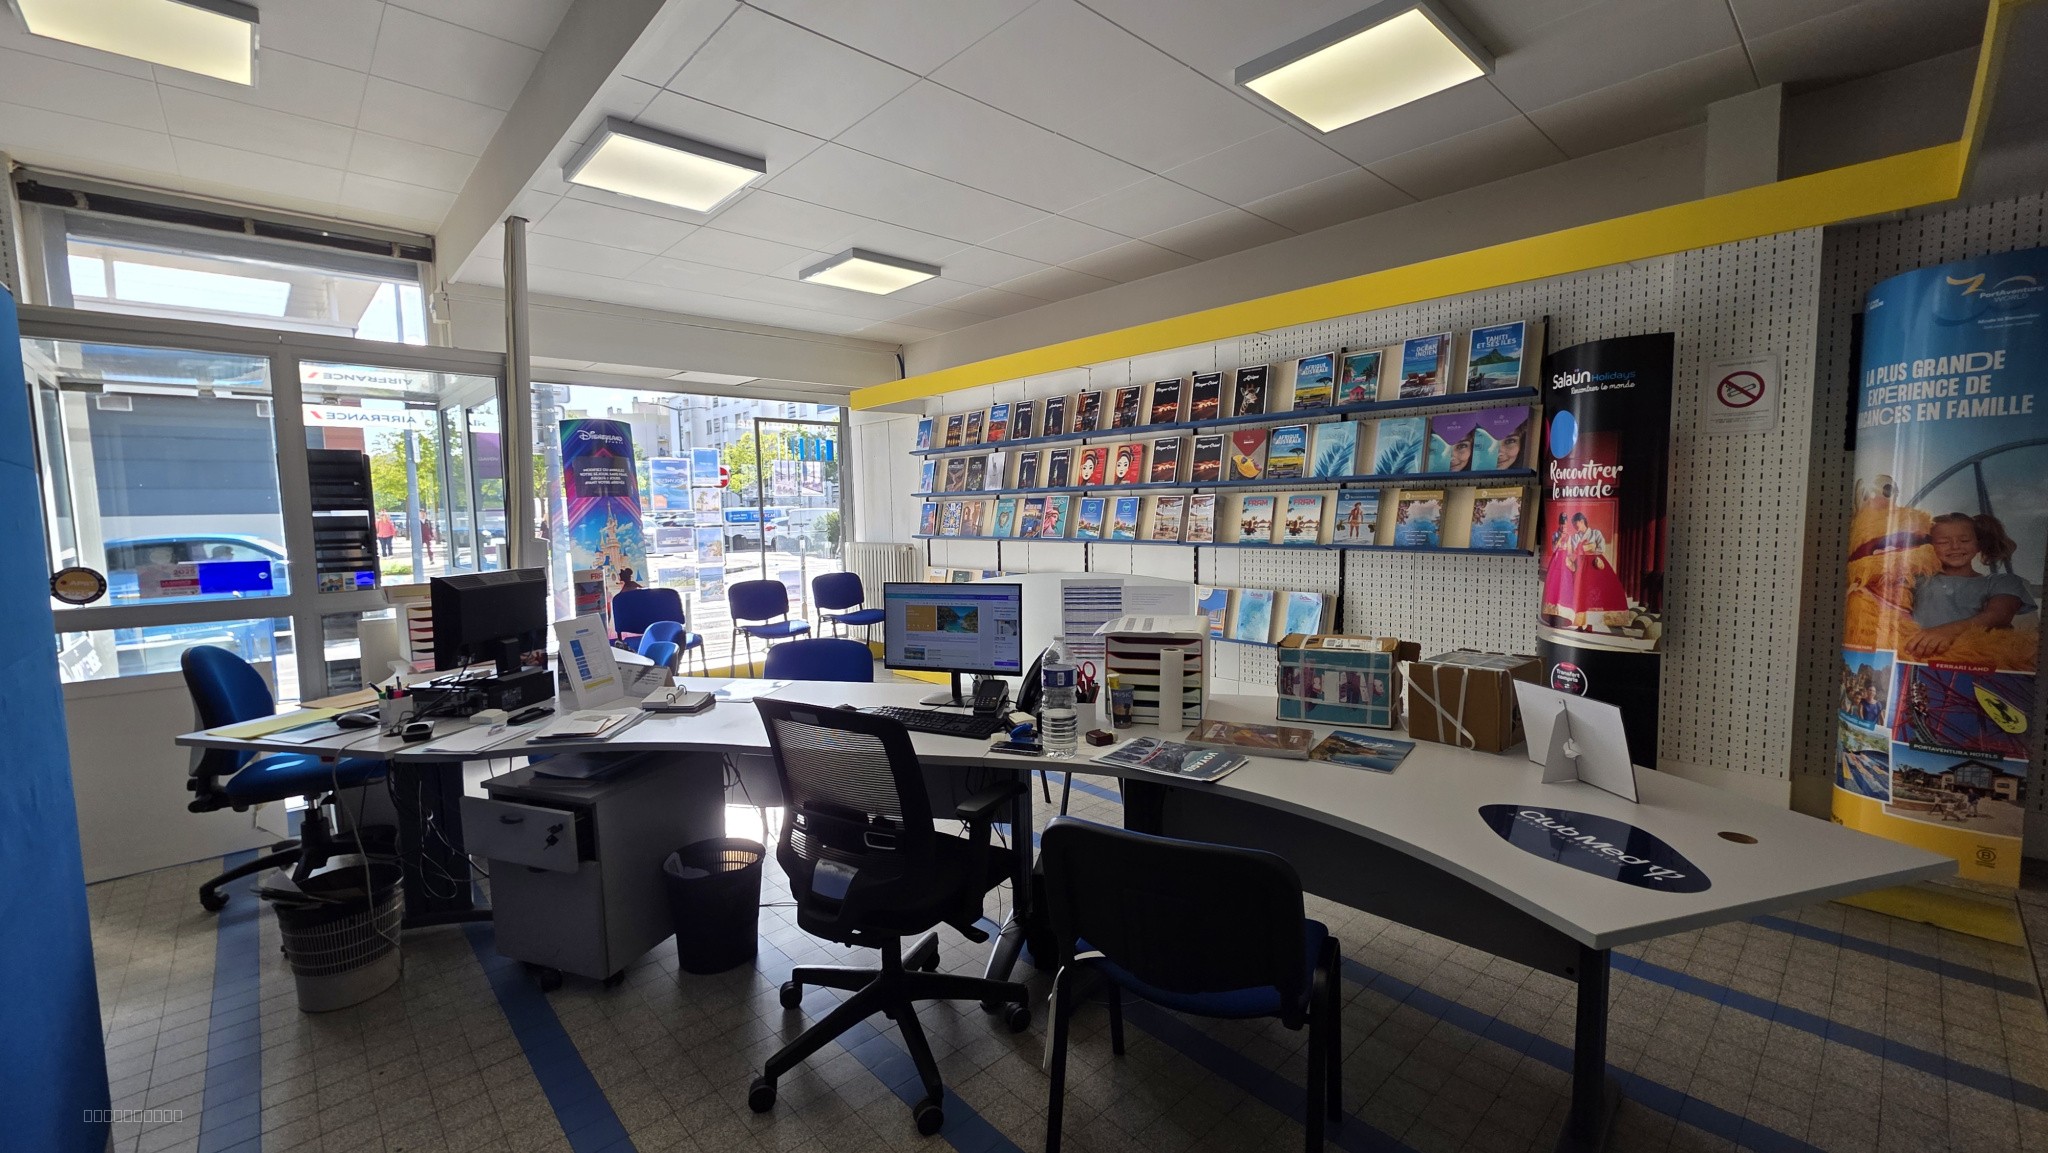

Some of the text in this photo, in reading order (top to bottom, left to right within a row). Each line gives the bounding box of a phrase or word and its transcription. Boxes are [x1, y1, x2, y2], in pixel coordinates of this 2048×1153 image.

[1591, 370, 1636, 382] Holidays
[1866, 349, 2006, 388] LA PLUS GRANDE
[1965, 374, 1992, 396] DE
[1916, 401, 1941, 421] EN
[1946, 394, 2035, 420] FAMILLE
[1550, 459, 1623, 484] Rencontrer
[1552, 478, 1614, 500] le monde
[1247, 499, 1269, 507] FRAM
[1294, 498, 1316, 506] FRAM
[1935, 662, 1990, 673] FERRARI LAND
[1913, 743, 1999, 760] PORTAVENTURA HOTELS
